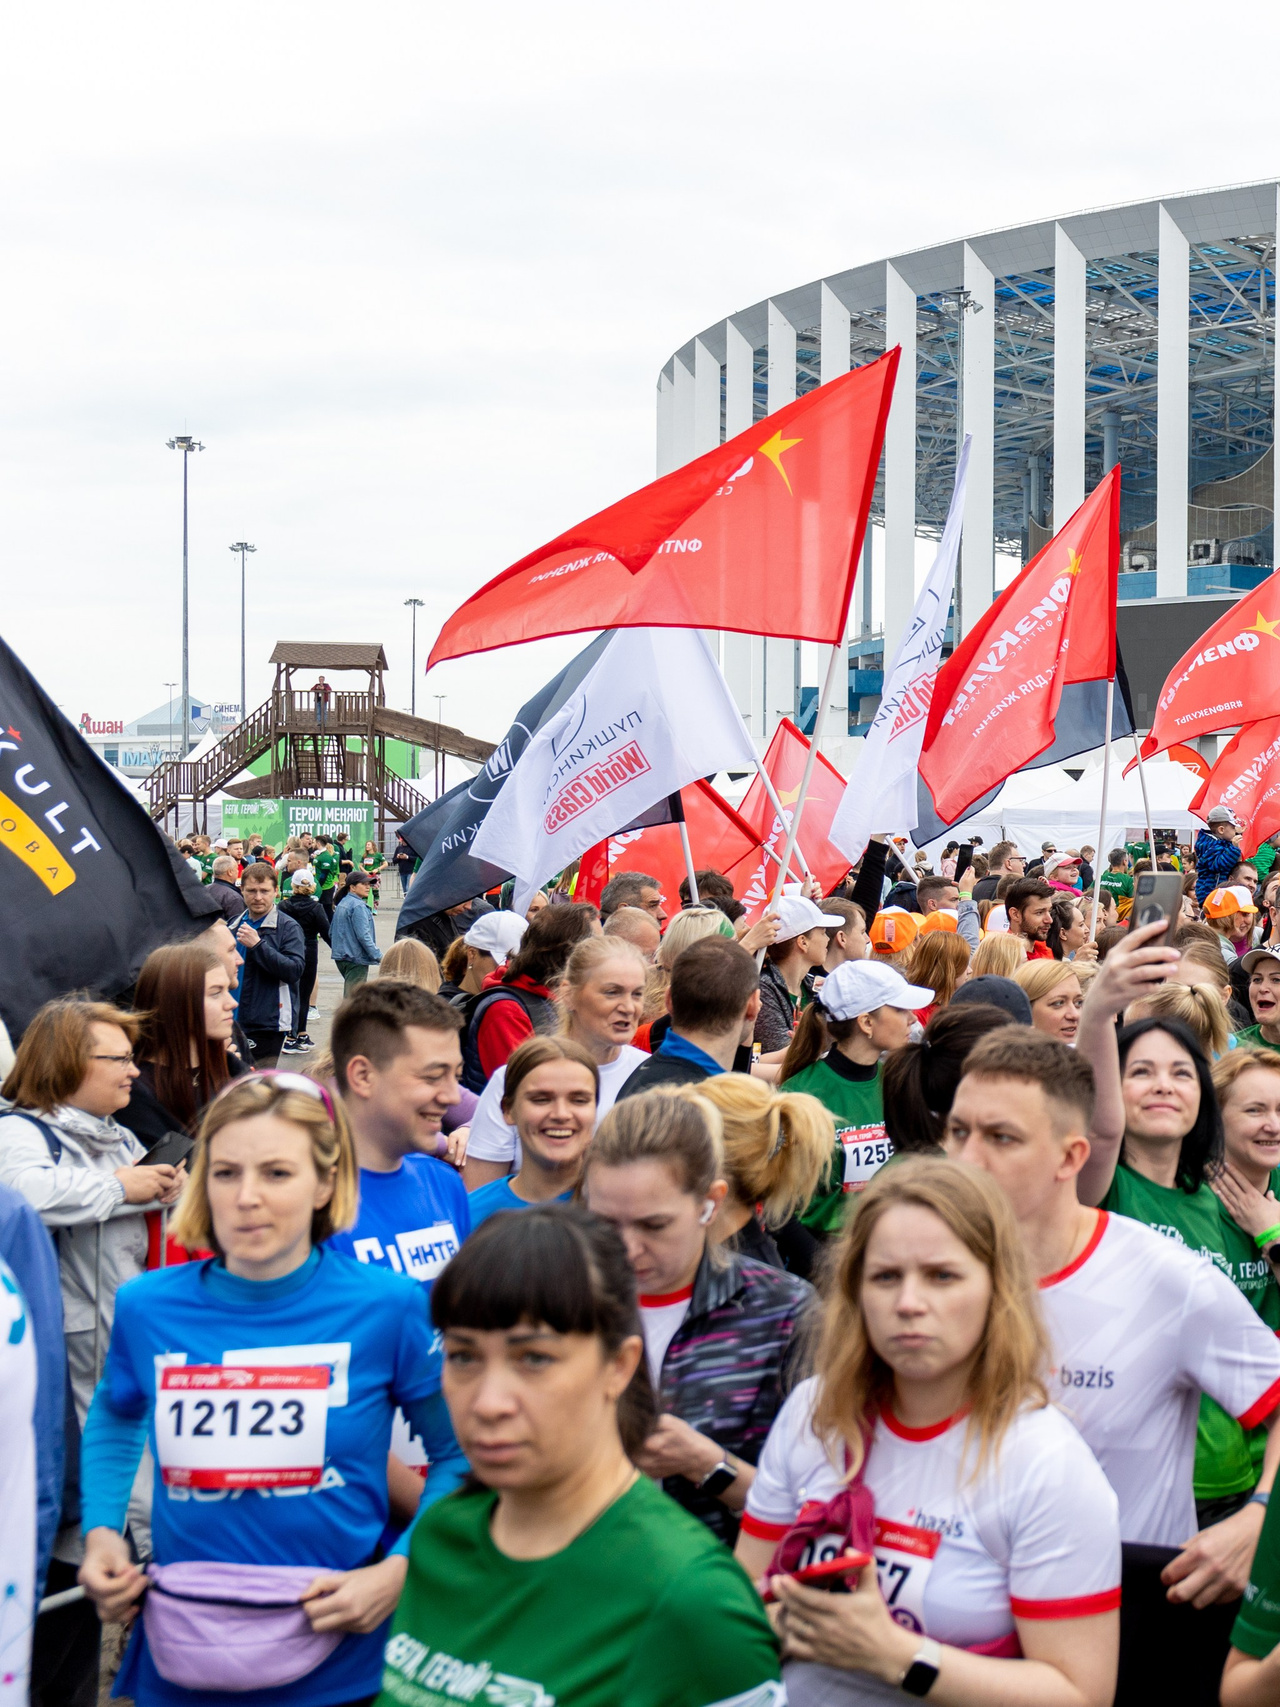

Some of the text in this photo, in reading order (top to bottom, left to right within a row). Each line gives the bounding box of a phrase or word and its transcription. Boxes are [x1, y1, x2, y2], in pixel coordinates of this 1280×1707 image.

[79, 713, 123, 734] Ашан
[225, 802, 260, 815] БЕГИ, ГЕРОЙ!
[289, 806, 368, 823] ГЕРОИ МЕНЯЮТ
[288, 823, 350, 840] ЭТОТ ГОРОД
[408, 1239, 457, 1267] ННТВ
[1061, 1364, 1114, 1389] bazis
[169, 1399, 305, 1436] 12123
